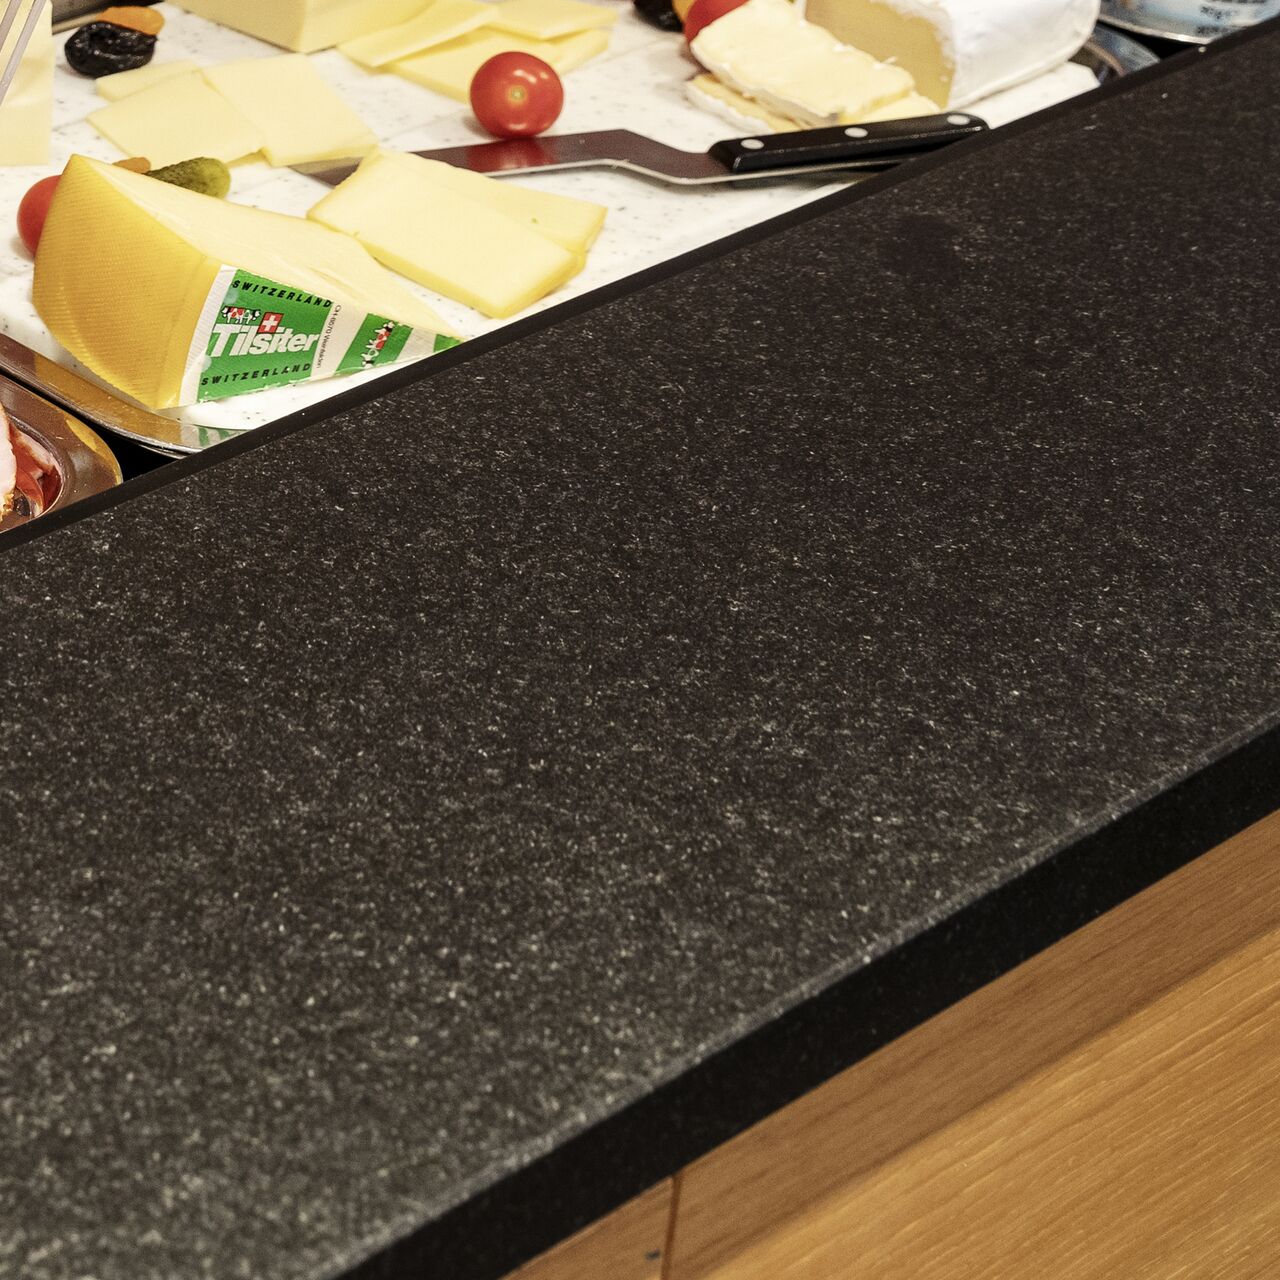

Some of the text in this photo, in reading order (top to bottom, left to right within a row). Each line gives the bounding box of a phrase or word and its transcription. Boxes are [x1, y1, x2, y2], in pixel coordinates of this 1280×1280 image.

[232, 280, 333, 308] SWITZERLAND
[209, 324, 320, 358] Tilsiter
[201, 363, 312, 385] SWITZERLAND
